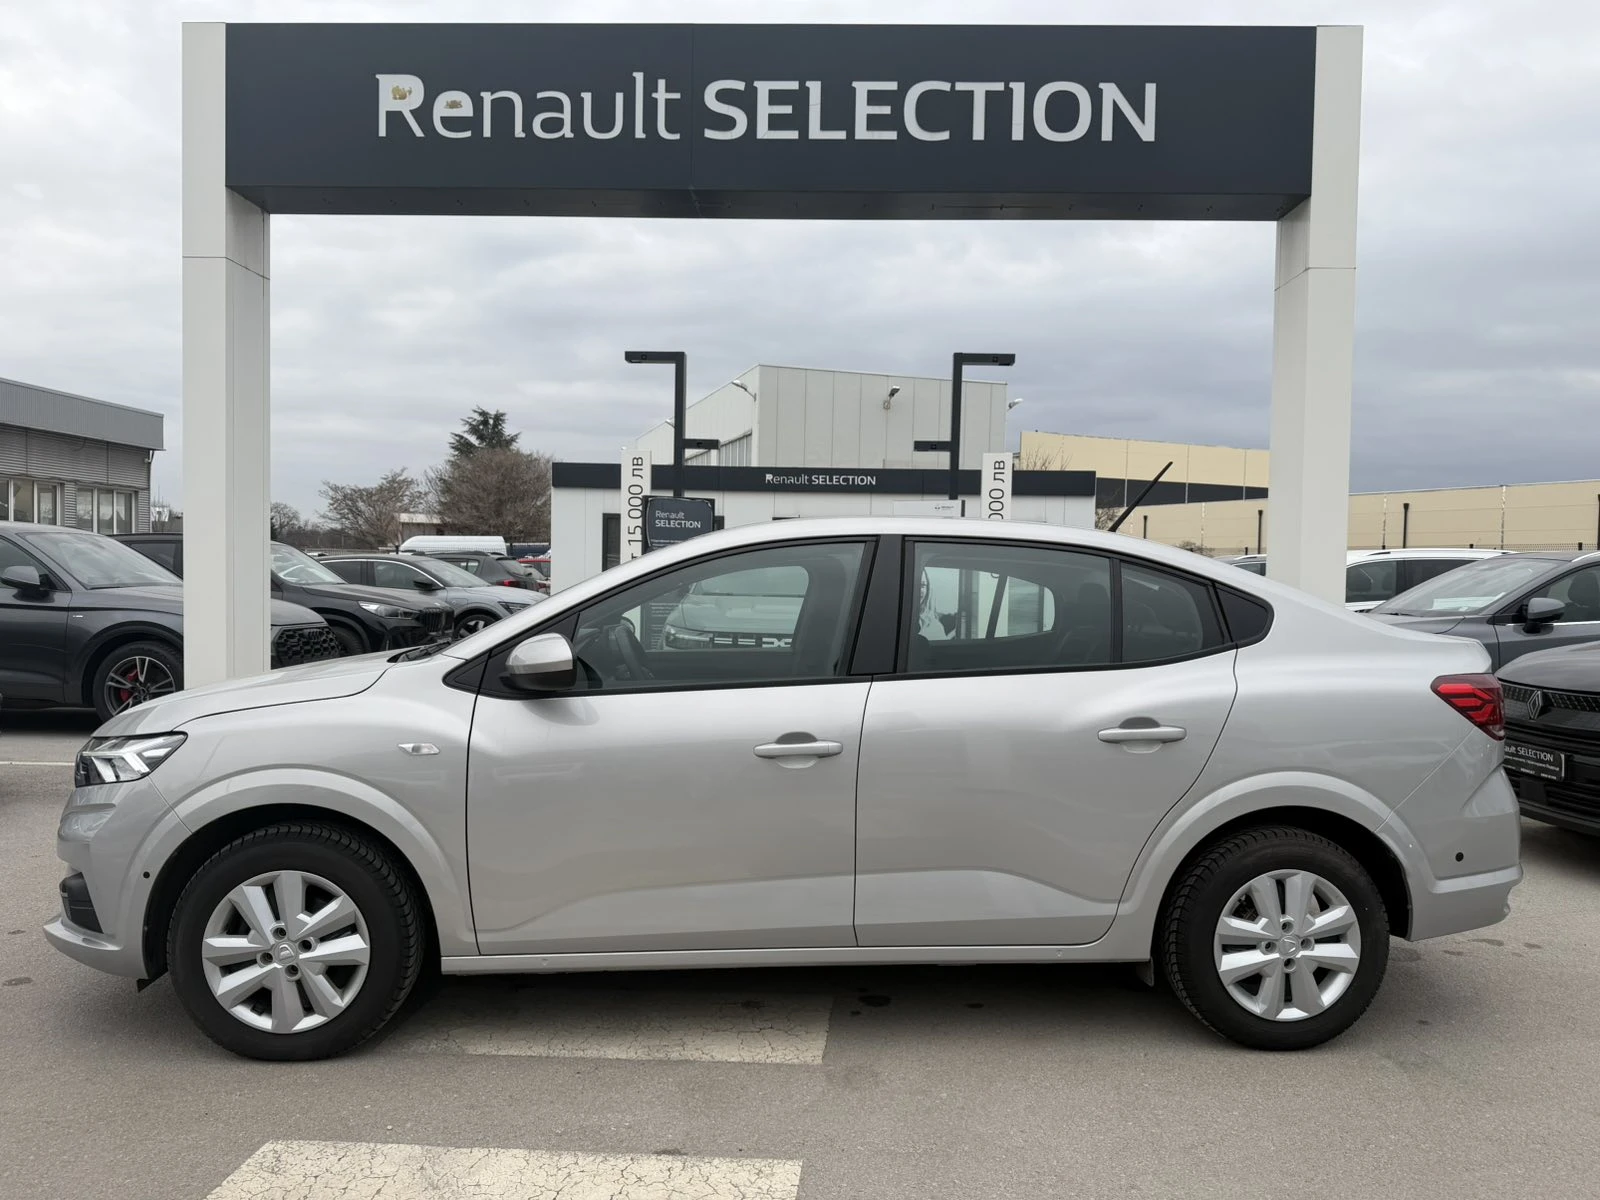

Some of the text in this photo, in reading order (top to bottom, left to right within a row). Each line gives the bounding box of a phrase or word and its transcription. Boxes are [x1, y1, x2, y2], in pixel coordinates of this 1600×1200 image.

[375, 71, 1157, 142] Renault SELECTION
[765, 473, 876, 486] Renault SELECTION
[627, 484, 643, 519] 000
[655, 510, 685, 519] Renault
[655, 519, 701, 529] SELECTION
[627, 525, 643, 546] 15
[1516, 746, 1554, 762] SELECTION
